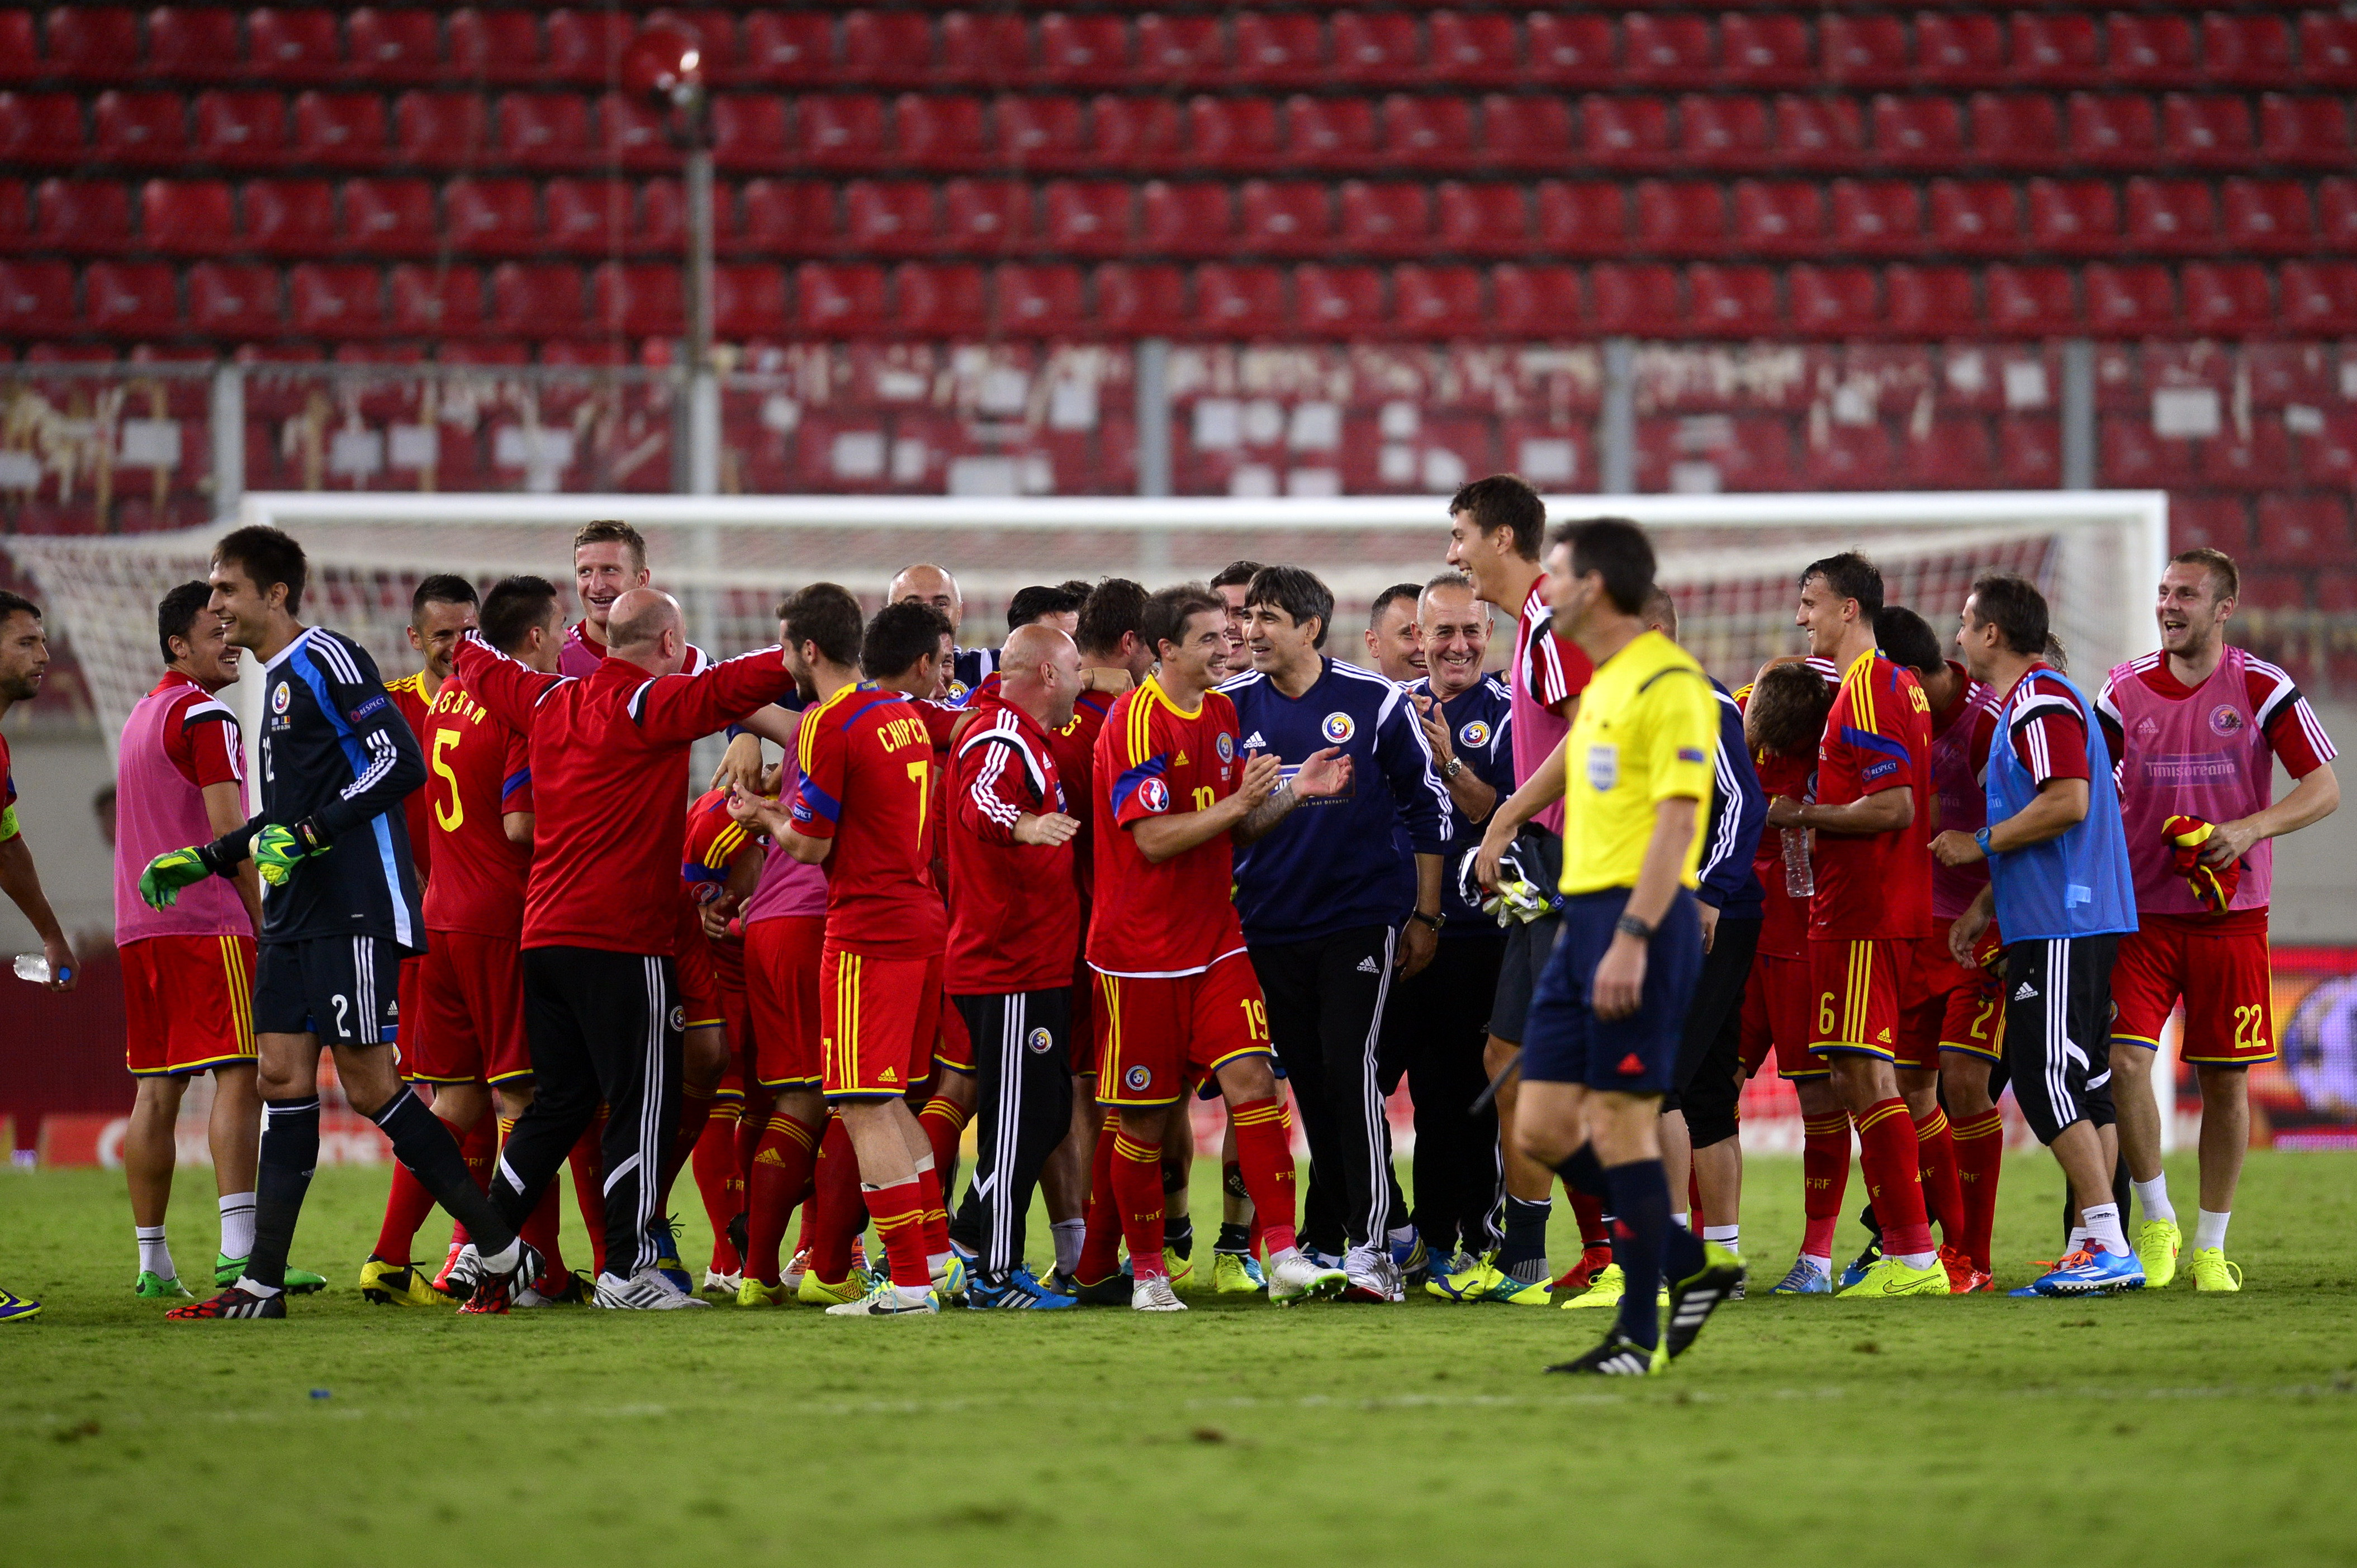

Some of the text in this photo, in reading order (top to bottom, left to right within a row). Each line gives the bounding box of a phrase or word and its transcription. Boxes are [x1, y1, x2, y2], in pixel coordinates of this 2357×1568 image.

[359, 697, 385, 715] RESPECT
[427, 690, 487, 725] HOBAN
[263, 736, 274, 782] 12
[1243, 740, 1267, 749] adidas
[432, 728, 463, 833] 5
[1871, 762, 1896, 775] RESPECT
[907, 760, 927, 852] 7
[1357, 965, 1379, 973] adidas
[1819, 992, 1835, 1034] 6
[2014, 990, 2038, 1001] adidas
[331, 994, 351, 1037] 2
[1240, 999, 1268, 1040] 19
[1970, 1000, 1994, 1040] 2
[2234, 1004, 2266, 1049] 22
[823, 1038, 831, 1082] 7
[754, 1154, 785, 1168] adidas
[1959, 1168, 1980, 1183] FRF
[1806, 1177, 1832, 1189] FRF
[1135, 1208, 1163, 1222] FRF
